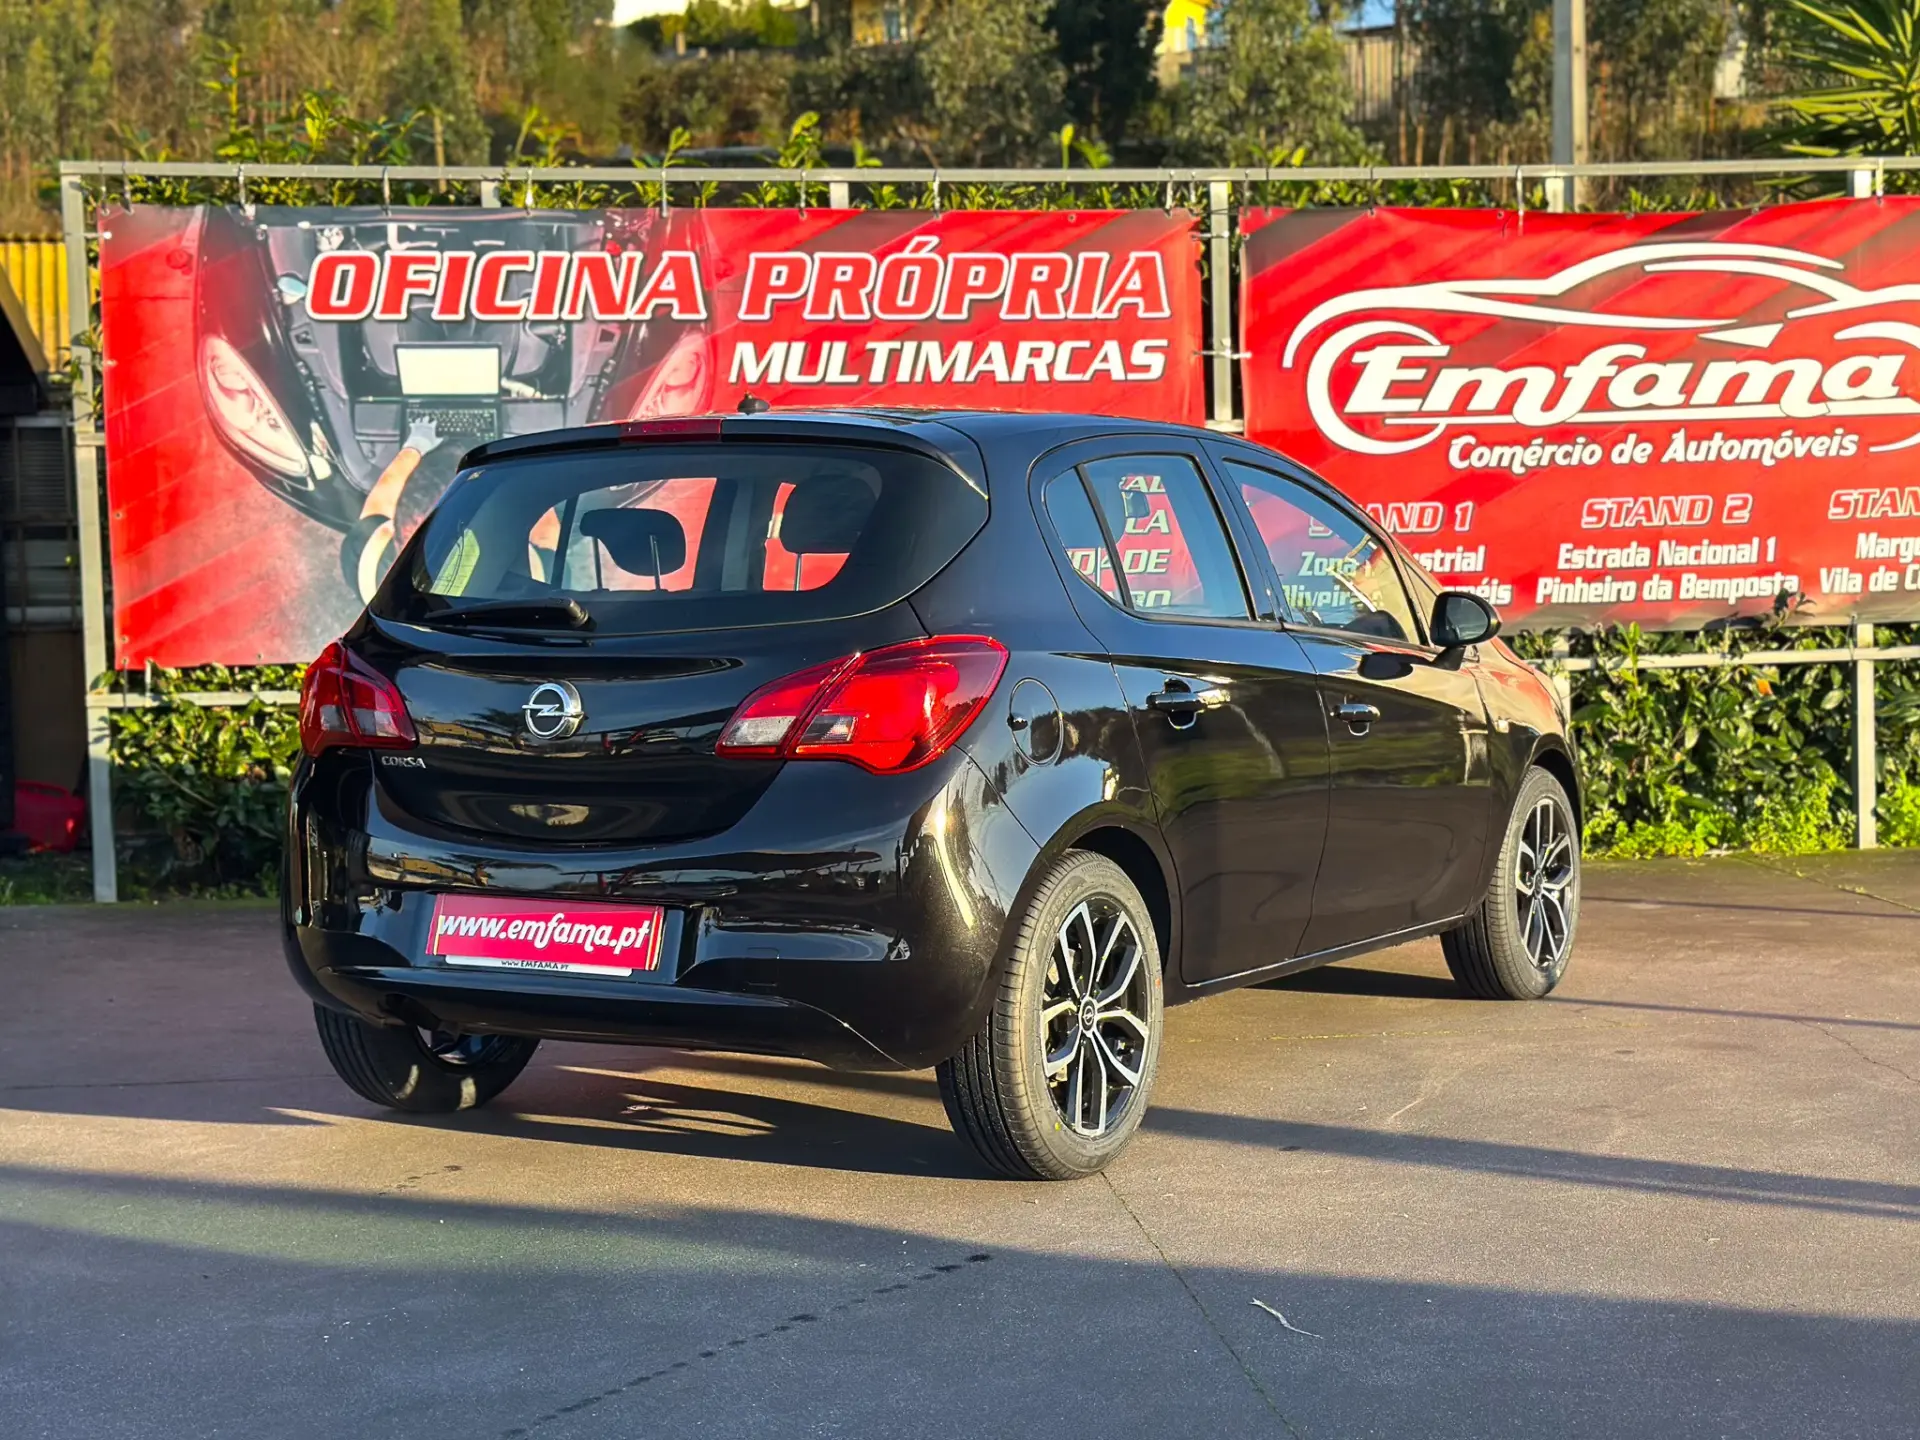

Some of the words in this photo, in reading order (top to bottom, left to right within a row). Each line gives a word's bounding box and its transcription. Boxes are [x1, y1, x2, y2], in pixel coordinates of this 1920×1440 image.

[305, 250, 707, 320] OFICINA
[738, 235, 1171, 320] PRÓPRIA
[728, 339, 1171, 384] MULTIMARCAS
[1342, 343, 1906, 427] Emfama
[1448, 436, 1602, 474] Comércio
[1611, 434, 1651, 465] de
[1661, 428, 1859, 467] Automóveis
[1455, 501, 1474, 532] 1
[1581, 495, 1714, 528] STAND
[1722, 493, 1752, 524] 2
[1557, 541, 1650, 569] Estrada
[1657, 537, 1759, 566] Nacional
[1766, 537, 1776, 562] 1
[1536, 576, 1637, 605] Pinheiro
[1642, 575, 1673, 601] da
[1680, 572, 1799, 605] Bemposta
[1820, 567, 1863, 593] Vila
[1869, 565, 1899, 592] de
[381, 755, 426, 769] CORSA
[439, 913, 650, 955] www.emfama.pt
